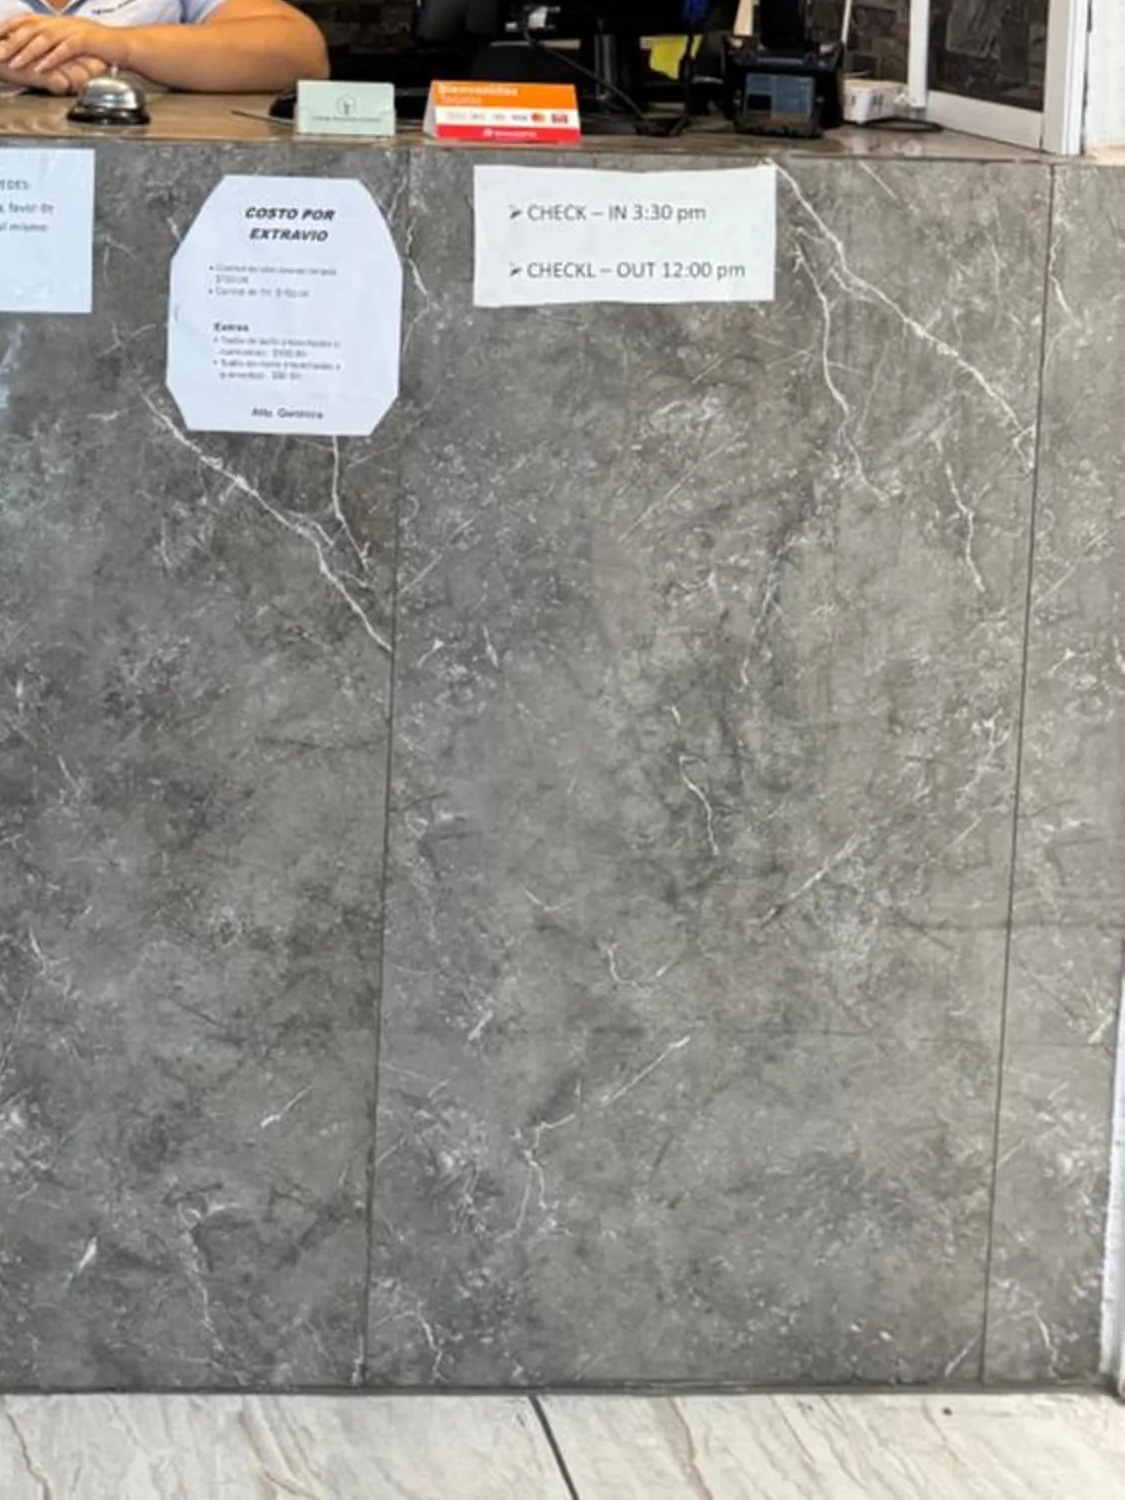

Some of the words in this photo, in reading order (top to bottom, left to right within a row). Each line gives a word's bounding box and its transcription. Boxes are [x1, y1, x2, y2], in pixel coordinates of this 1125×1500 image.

[245, 206, 298, 221] COSTO
[302, 208, 336, 222] POR
[527, 204, 587, 221] CHECK
[609, 204, 627, 220] IN
[632, 204, 673, 221] 3:30
[677, 208, 707, 224] pm
[249, 228, 329, 242] EXTRAVIO
[527, 261, 596, 278] CHECKL
[617, 262, 656, 278] OUT
[663, 262, 712, 279] 12:00
[716, 264, 746, 281] pm
